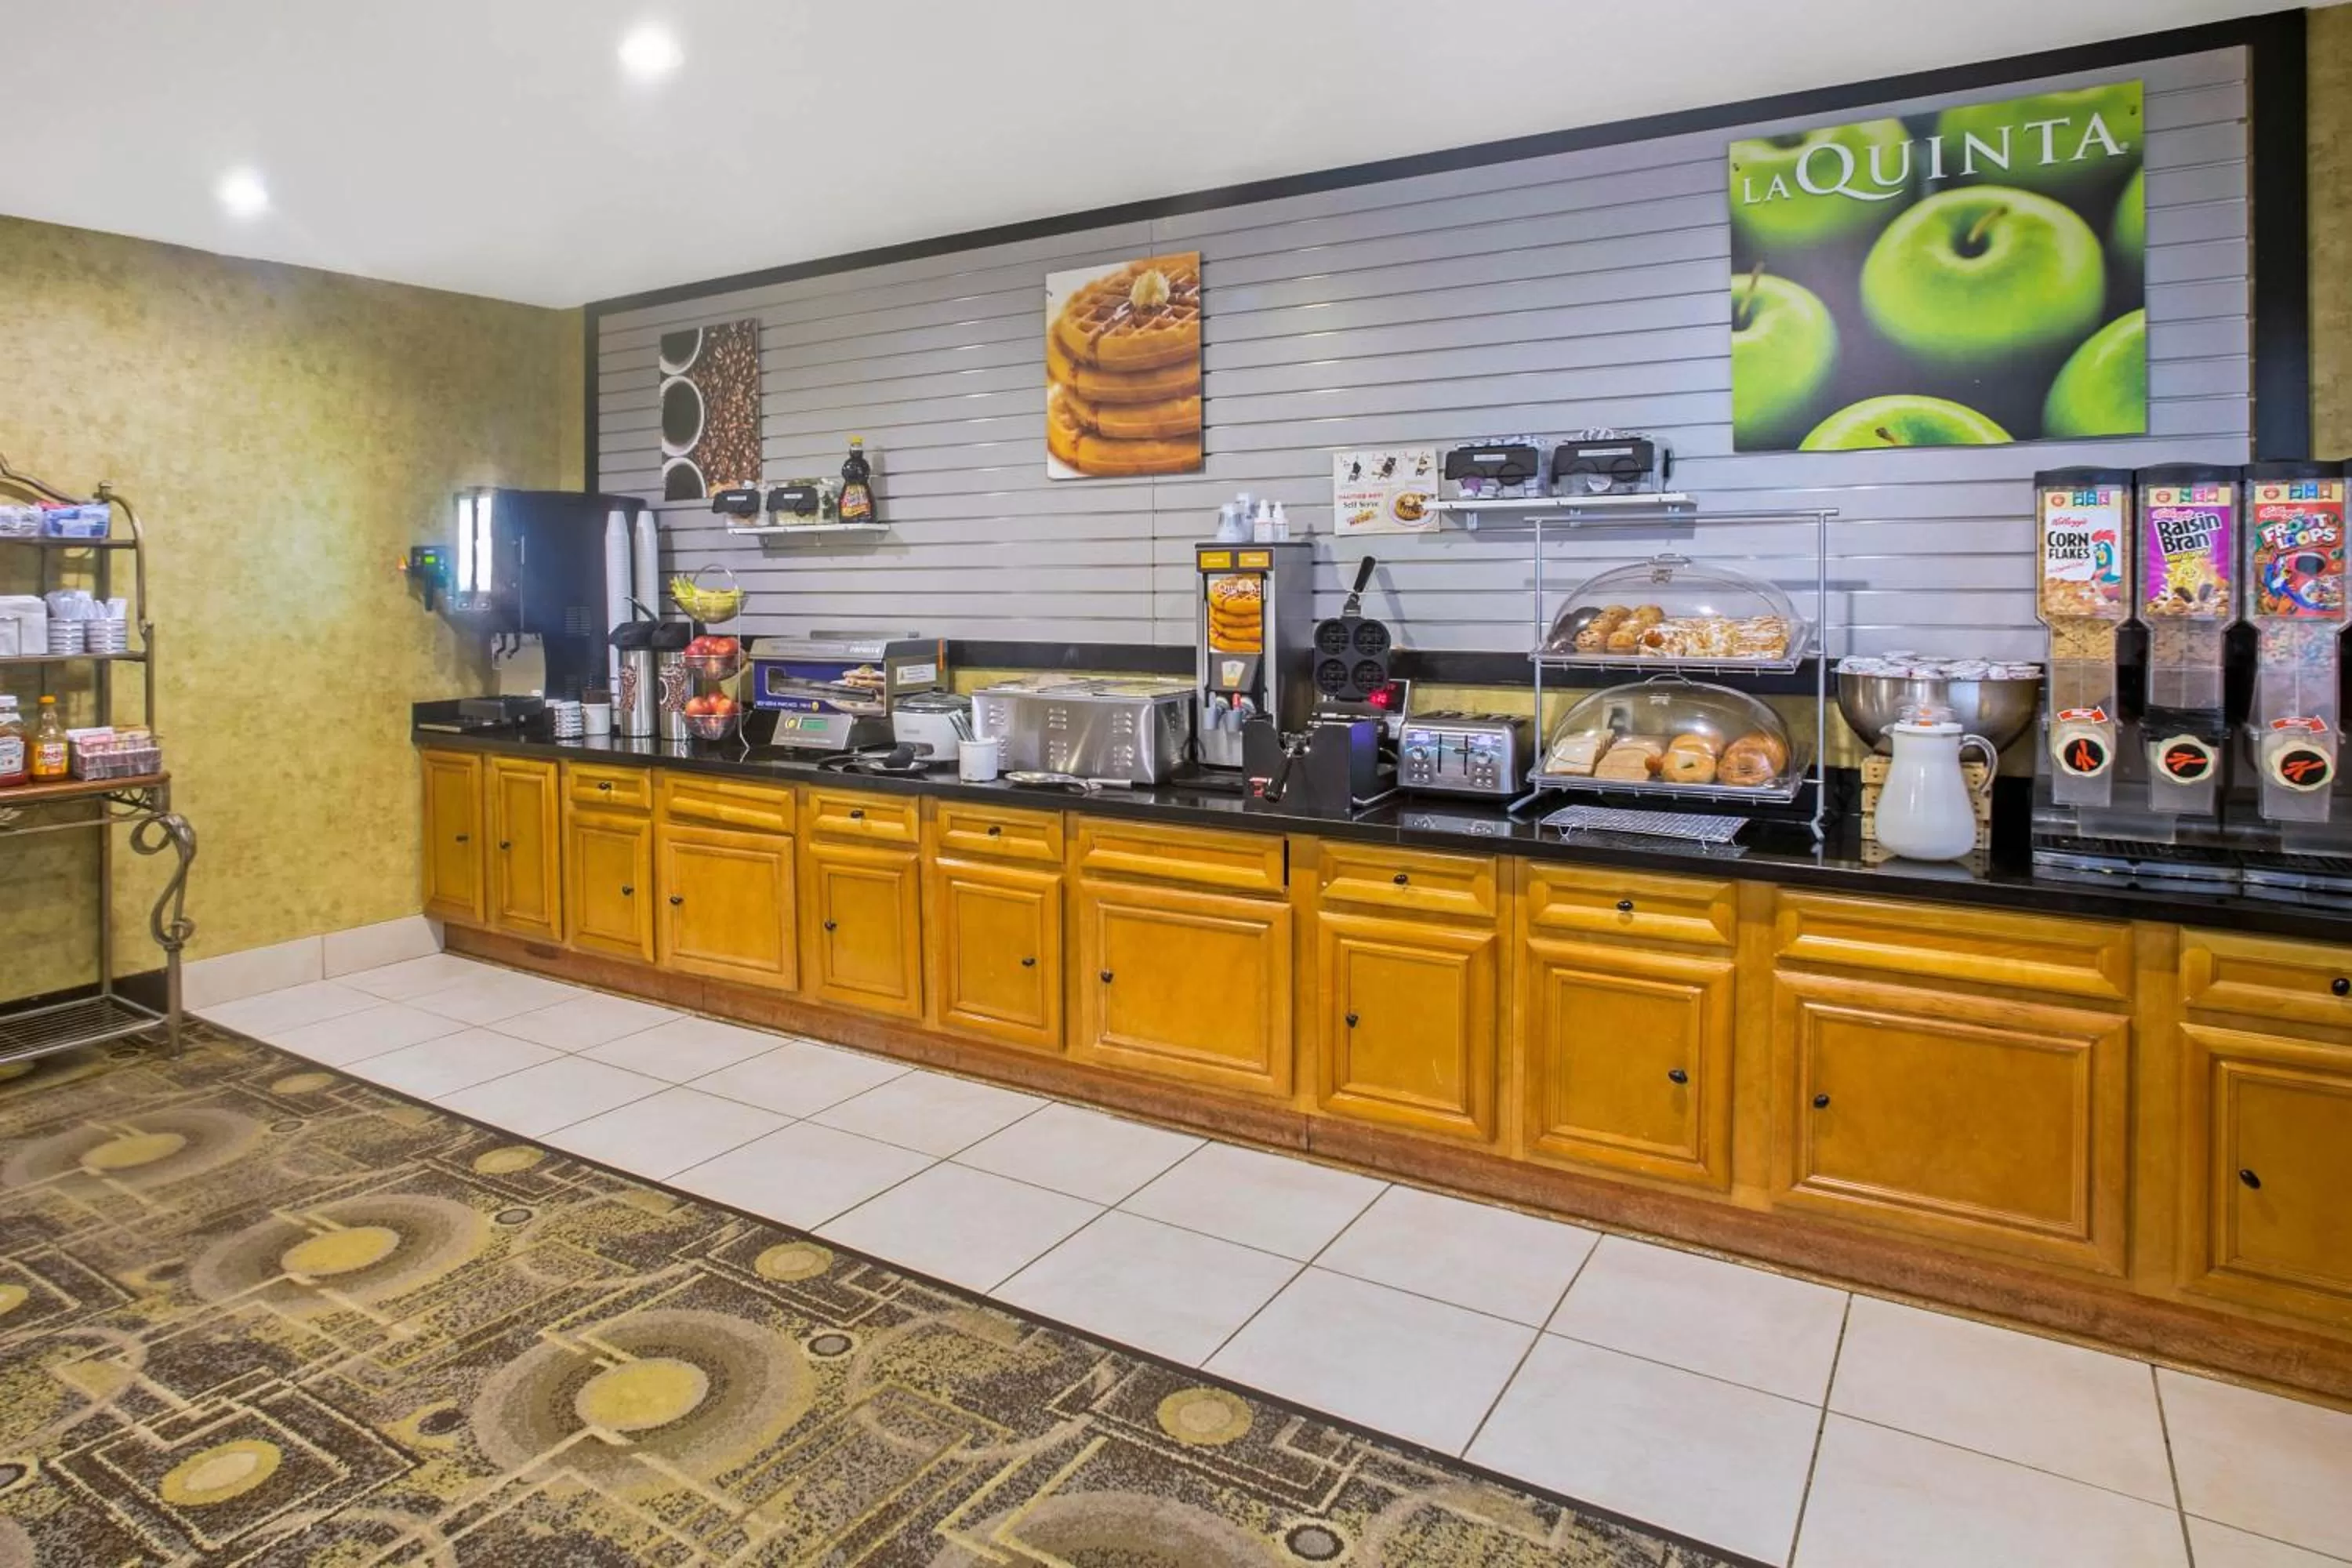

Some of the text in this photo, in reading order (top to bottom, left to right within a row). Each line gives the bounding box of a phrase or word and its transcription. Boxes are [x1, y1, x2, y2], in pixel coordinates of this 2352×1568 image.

[1743, 112, 2128, 204] LA QUINTA
[2157, 513, 2220, 536] Raisin
[2261, 513, 2328, 543] FROOT
[2047, 531, 2089, 547] CORN
[2161, 533, 2210, 554] Bran
[2276, 526, 2337, 550] LOOPS
[2049, 548, 2091, 559] FLAKES
